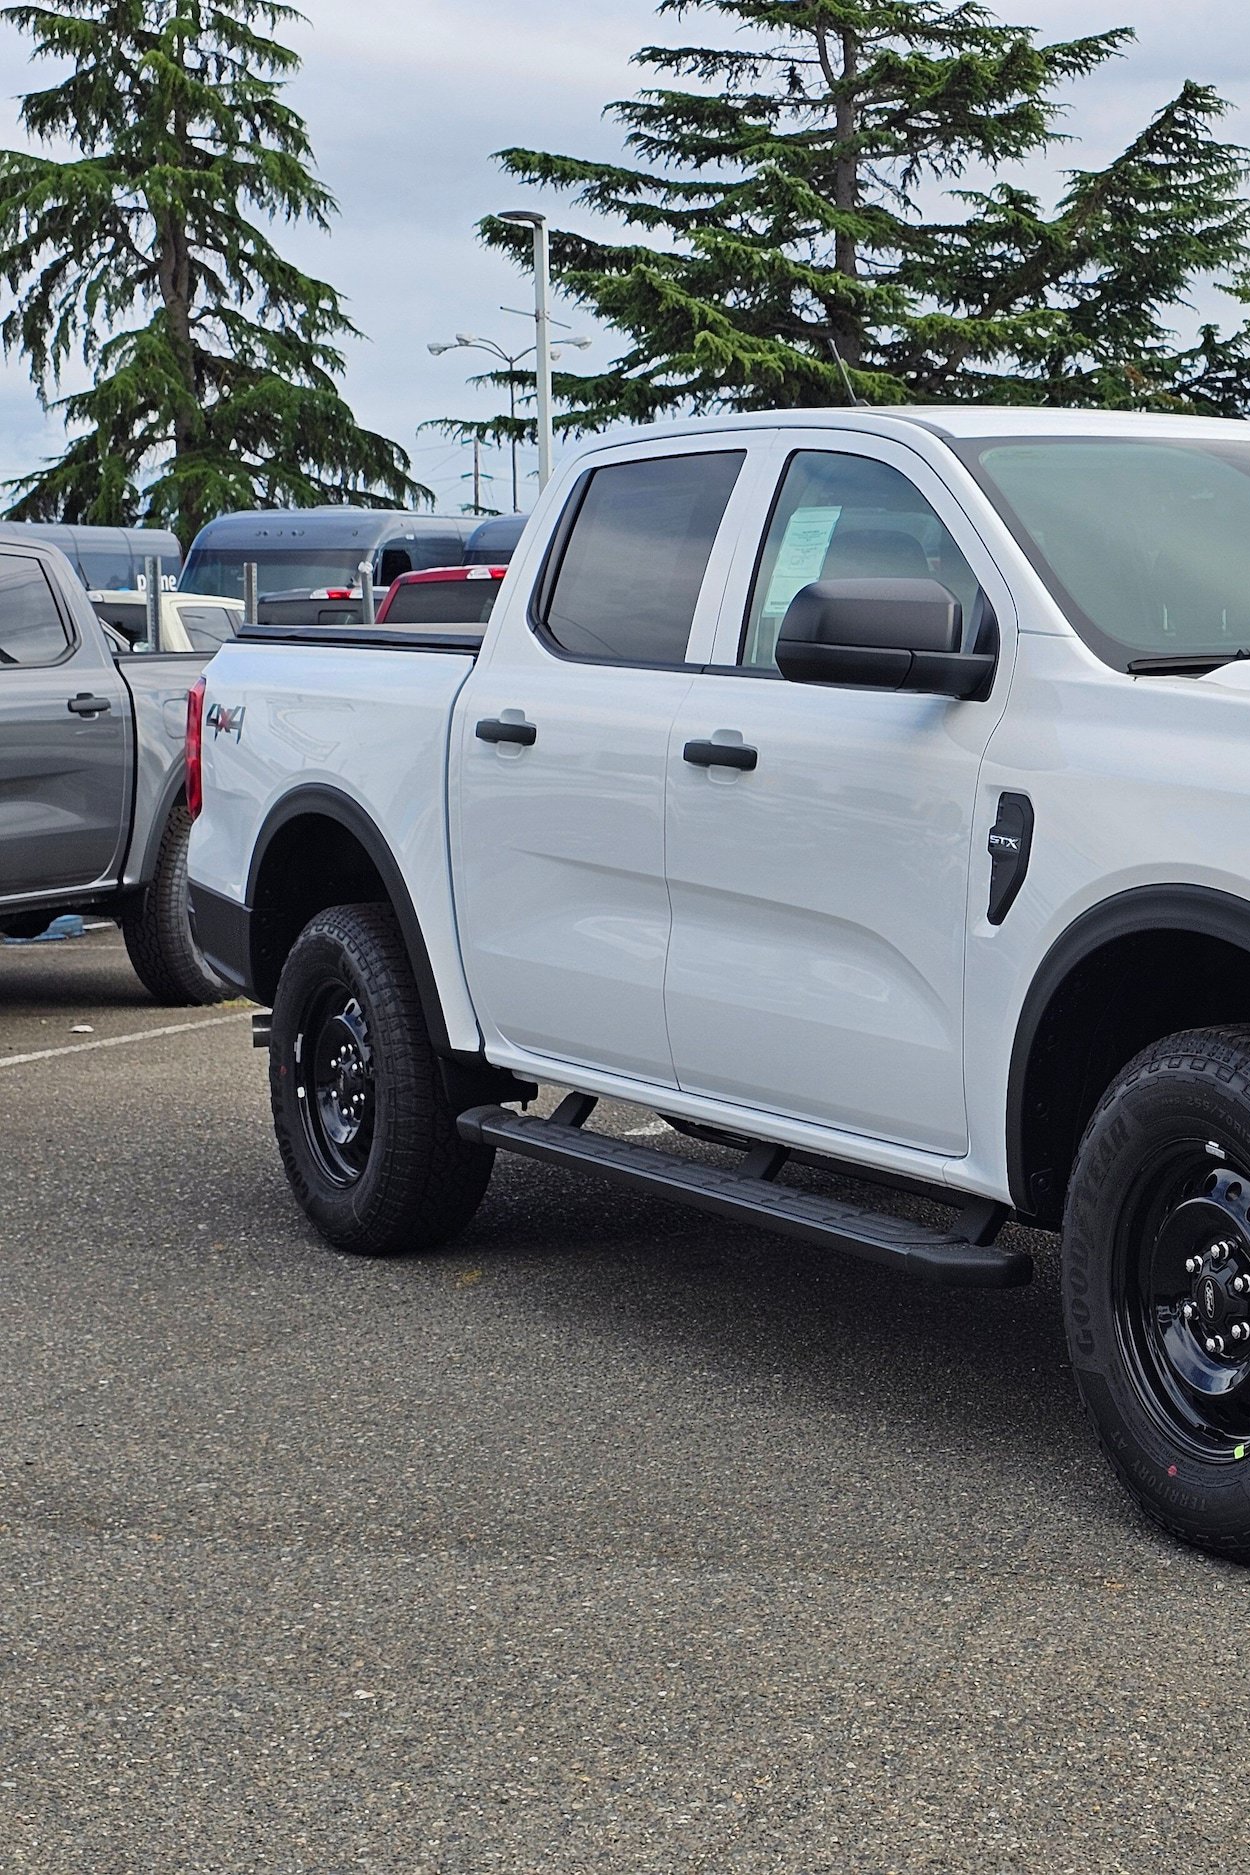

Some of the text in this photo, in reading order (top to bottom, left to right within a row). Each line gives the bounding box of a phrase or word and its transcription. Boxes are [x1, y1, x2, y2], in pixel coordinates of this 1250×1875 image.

[990, 834, 1019, 850] STX
[1110, 1430, 1129, 1450] AT
[1130, 1459, 1208, 1512] TERRITORY
